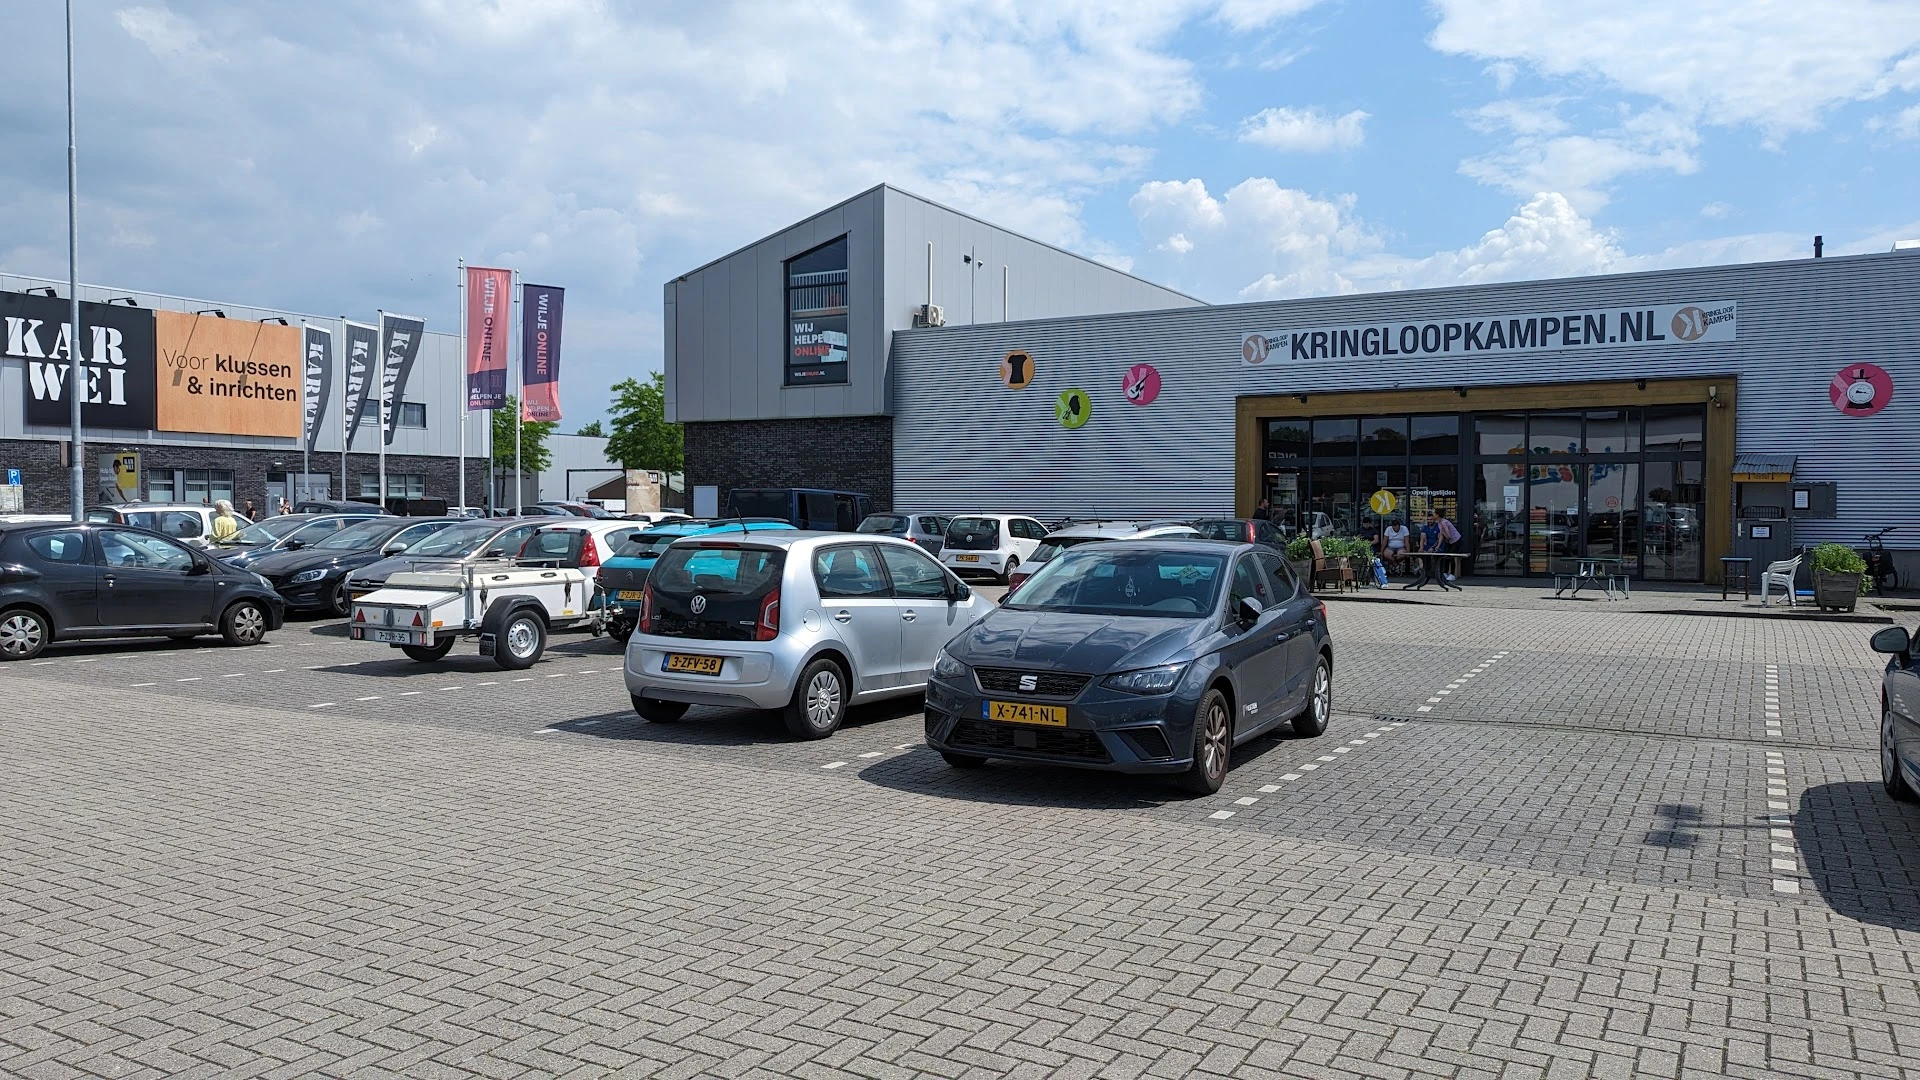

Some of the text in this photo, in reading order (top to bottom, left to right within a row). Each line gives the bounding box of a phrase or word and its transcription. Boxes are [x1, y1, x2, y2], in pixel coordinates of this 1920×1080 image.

[537, 293, 549, 330] WILJE
[1701, 305, 1735, 319] KRINGLOOP
[1703, 313, 1734, 327] KAMPEN
[5, 316, 127, 366] KAR
[794, 323, 814, 333] WIJ
[1291, 310, 1665, 360] KRINGLOOPKAMPEN.NL
[163, 347, 292, 378] Voor klussen
[536, 331, 547, 375] ONLINE
[29, 361, 127, 406] WEI
[187, 375, 297, 402] & inrichten
[383, 331, 411, 432] KARWEI
[10, 470, 18, 479] P
[1411, 489, 1456, 497] Openingstijden
[672, 656, 717, 671] 3-ZFV-58
[996, 704, 1060, 723] X-741-NL
